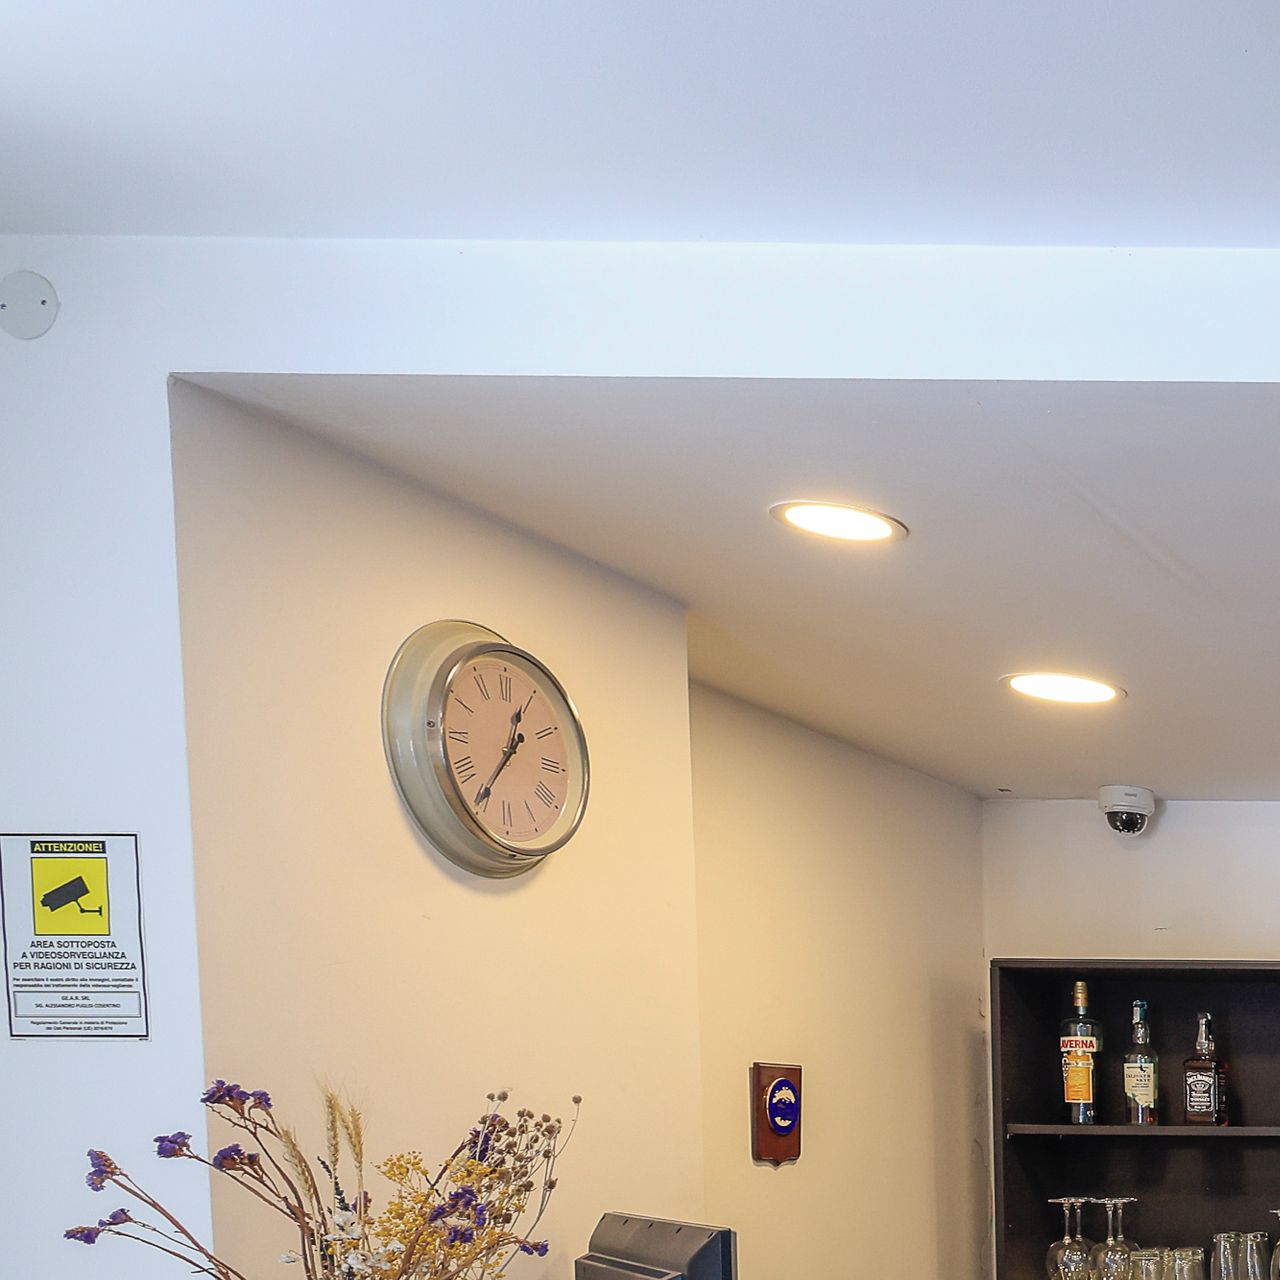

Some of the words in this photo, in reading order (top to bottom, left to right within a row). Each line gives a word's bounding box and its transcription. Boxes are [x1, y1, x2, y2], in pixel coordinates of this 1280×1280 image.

[33, 842, 103, 853] ATTENZIONE!
[30, 941, 55, 949] AREA
[57, 940, 116, 949] SOTTOPOSTA
[21, 951, 28, 959] A
[29, 951, 127, 960] VIDEOSORVEGLIANZA
[13, 962, 32, 970] PER
[33, 962, 72, 970] RAGIONI
[74, 962, 84, 970] DI
[86, 962, 137, 971] SICUREZZA
[1061, 1039, 1095, 1049] AVERNA
